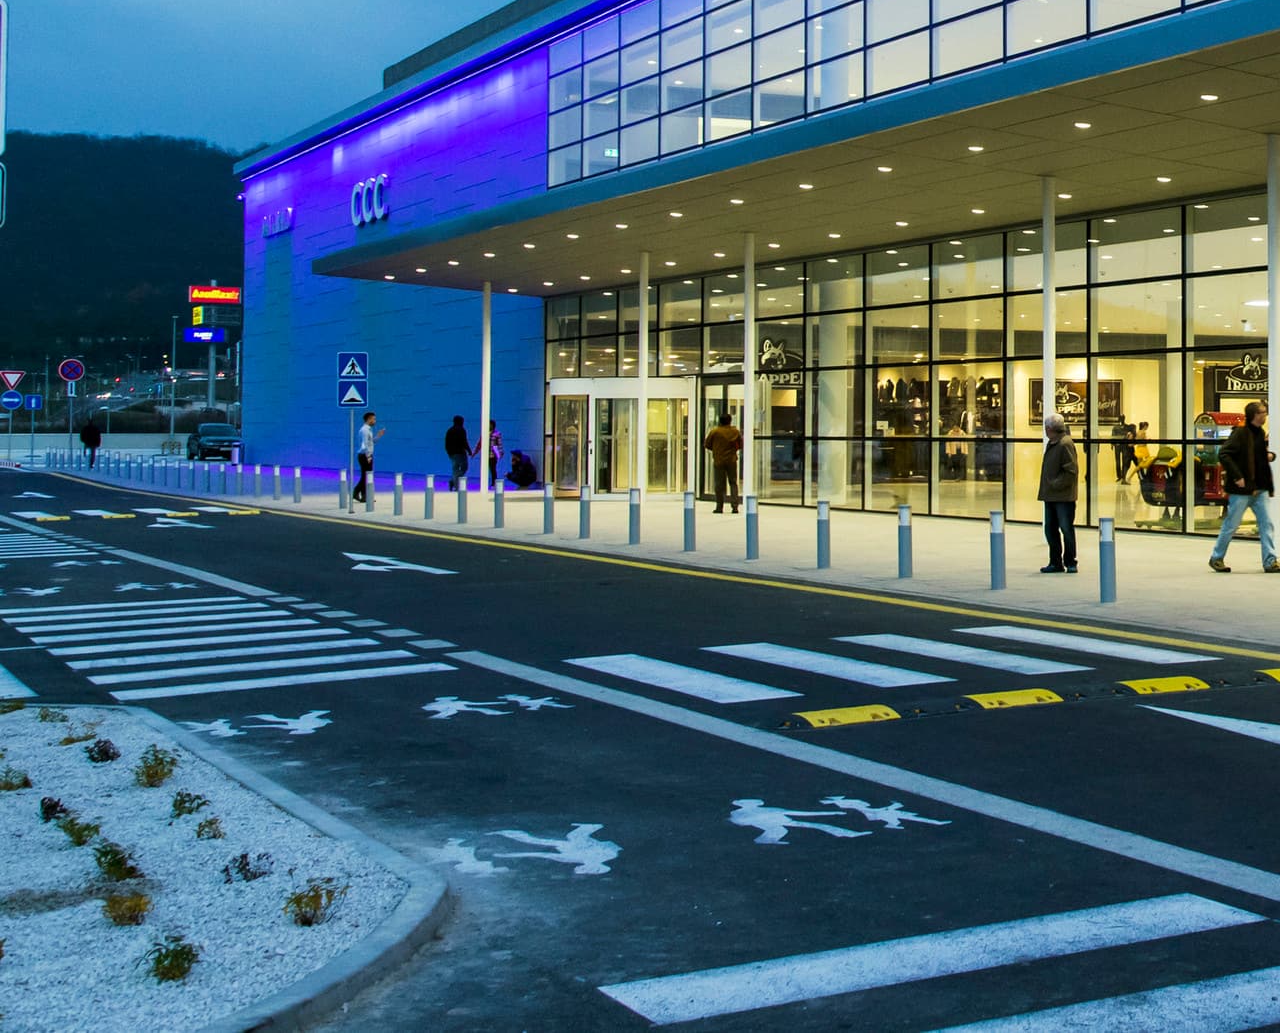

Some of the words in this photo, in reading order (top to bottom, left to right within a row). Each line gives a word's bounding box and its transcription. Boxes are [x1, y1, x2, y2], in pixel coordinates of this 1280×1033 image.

[351, 173, 389, 226] CCC
[759, 371, 803, 385] APPE
[1225, 375, 1269, 391] TRAPPE
[1036, 400, 1085, 414] TPPER
